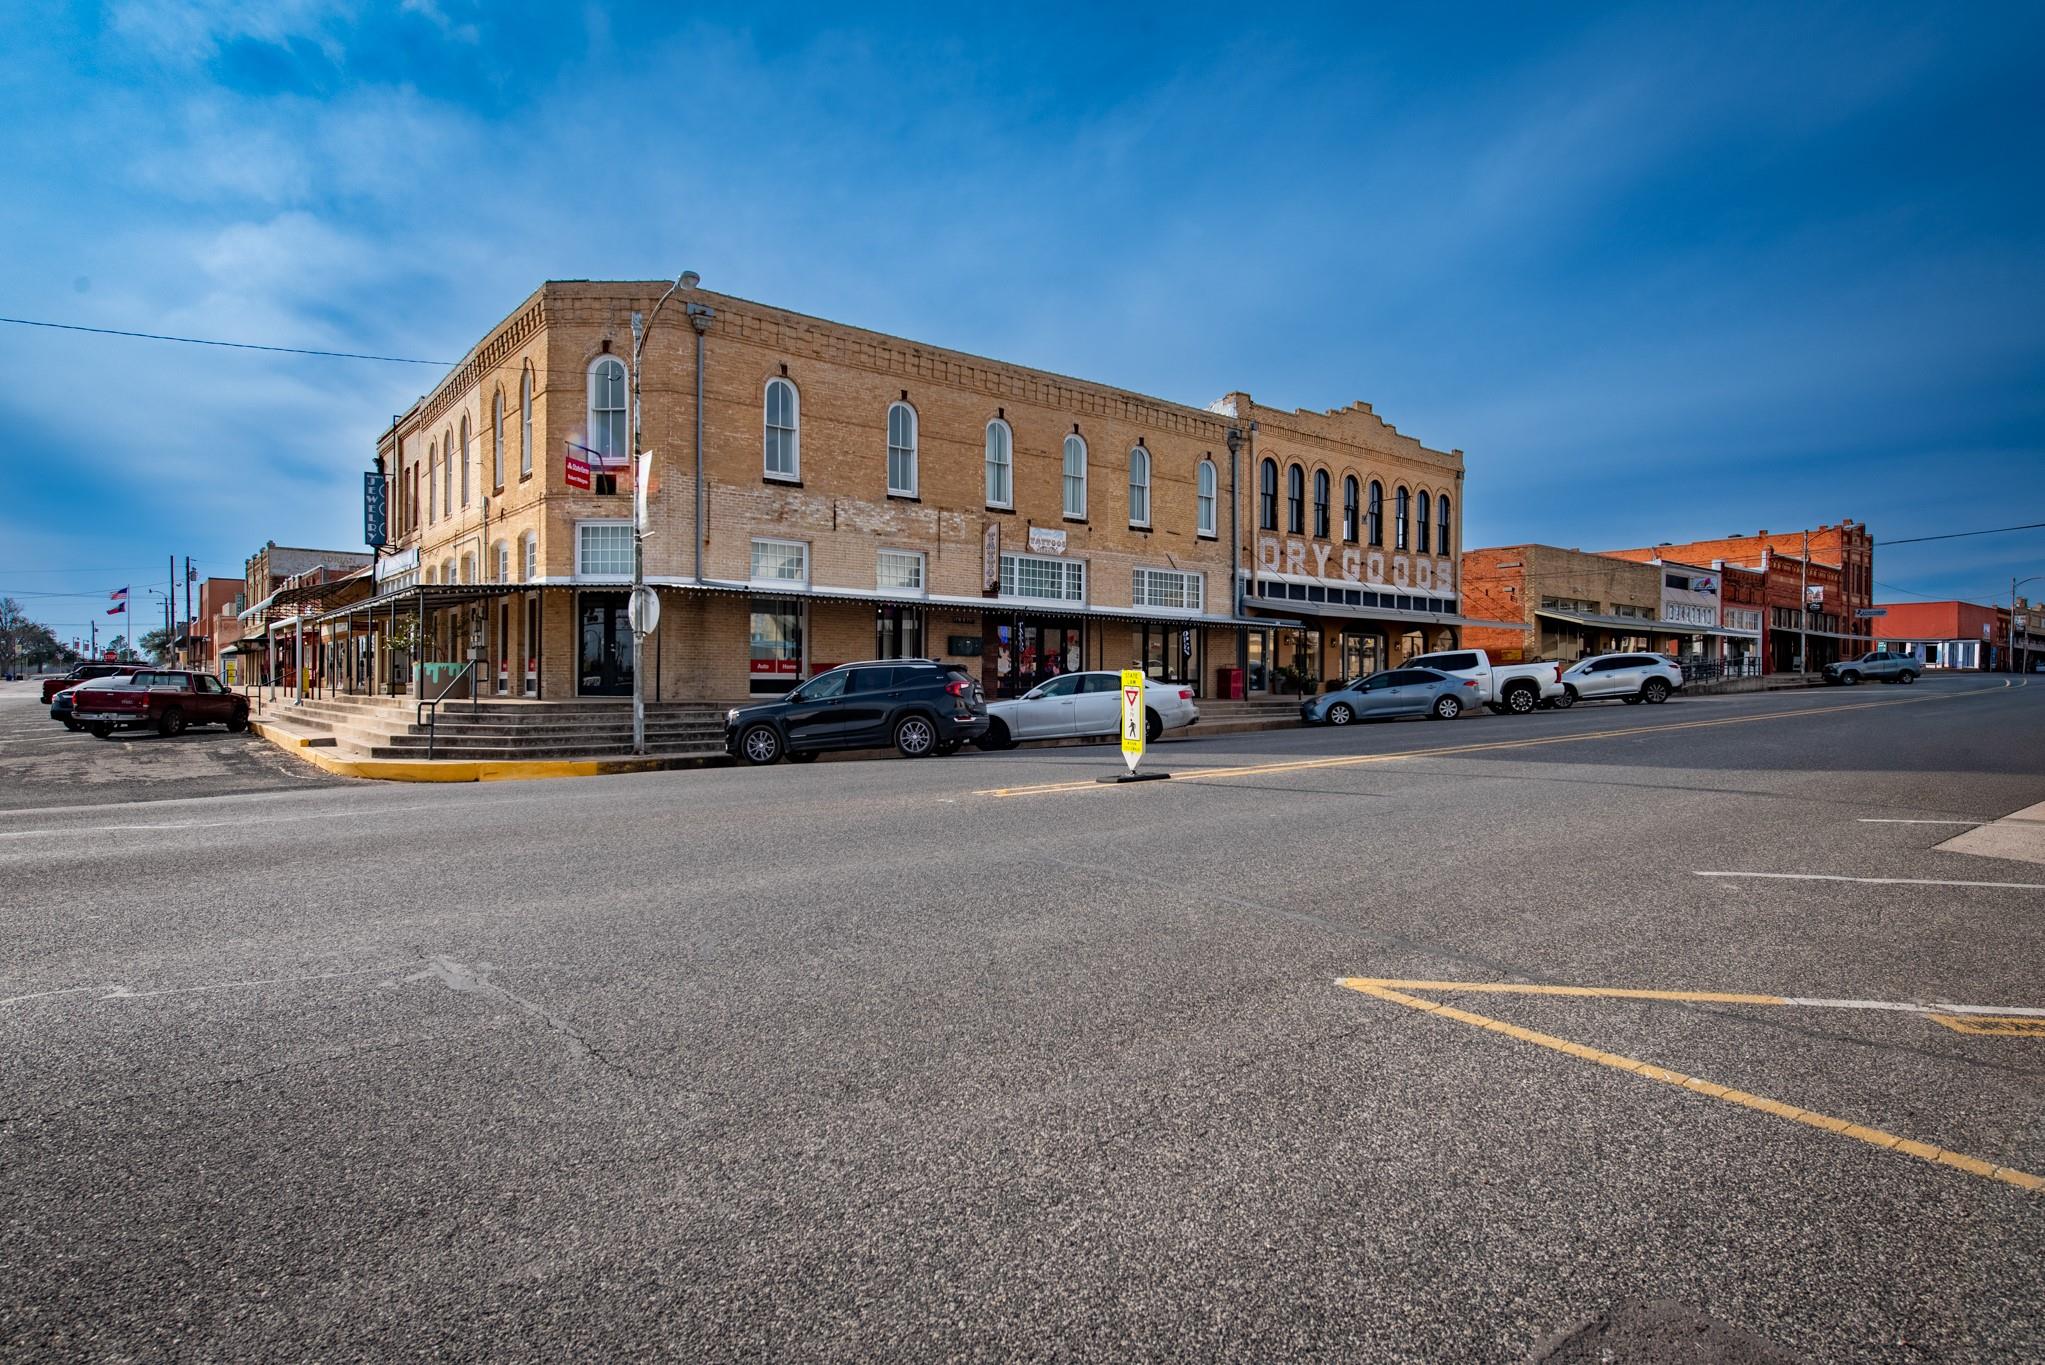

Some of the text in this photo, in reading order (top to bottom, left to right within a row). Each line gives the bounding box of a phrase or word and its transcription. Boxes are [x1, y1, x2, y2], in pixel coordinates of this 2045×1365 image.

[366, 477, 378, 542] JEWELRY
[1030, 536, 1067, 549] TATTOOS
[1259, 536, 1451, 592] DRY GOODS
